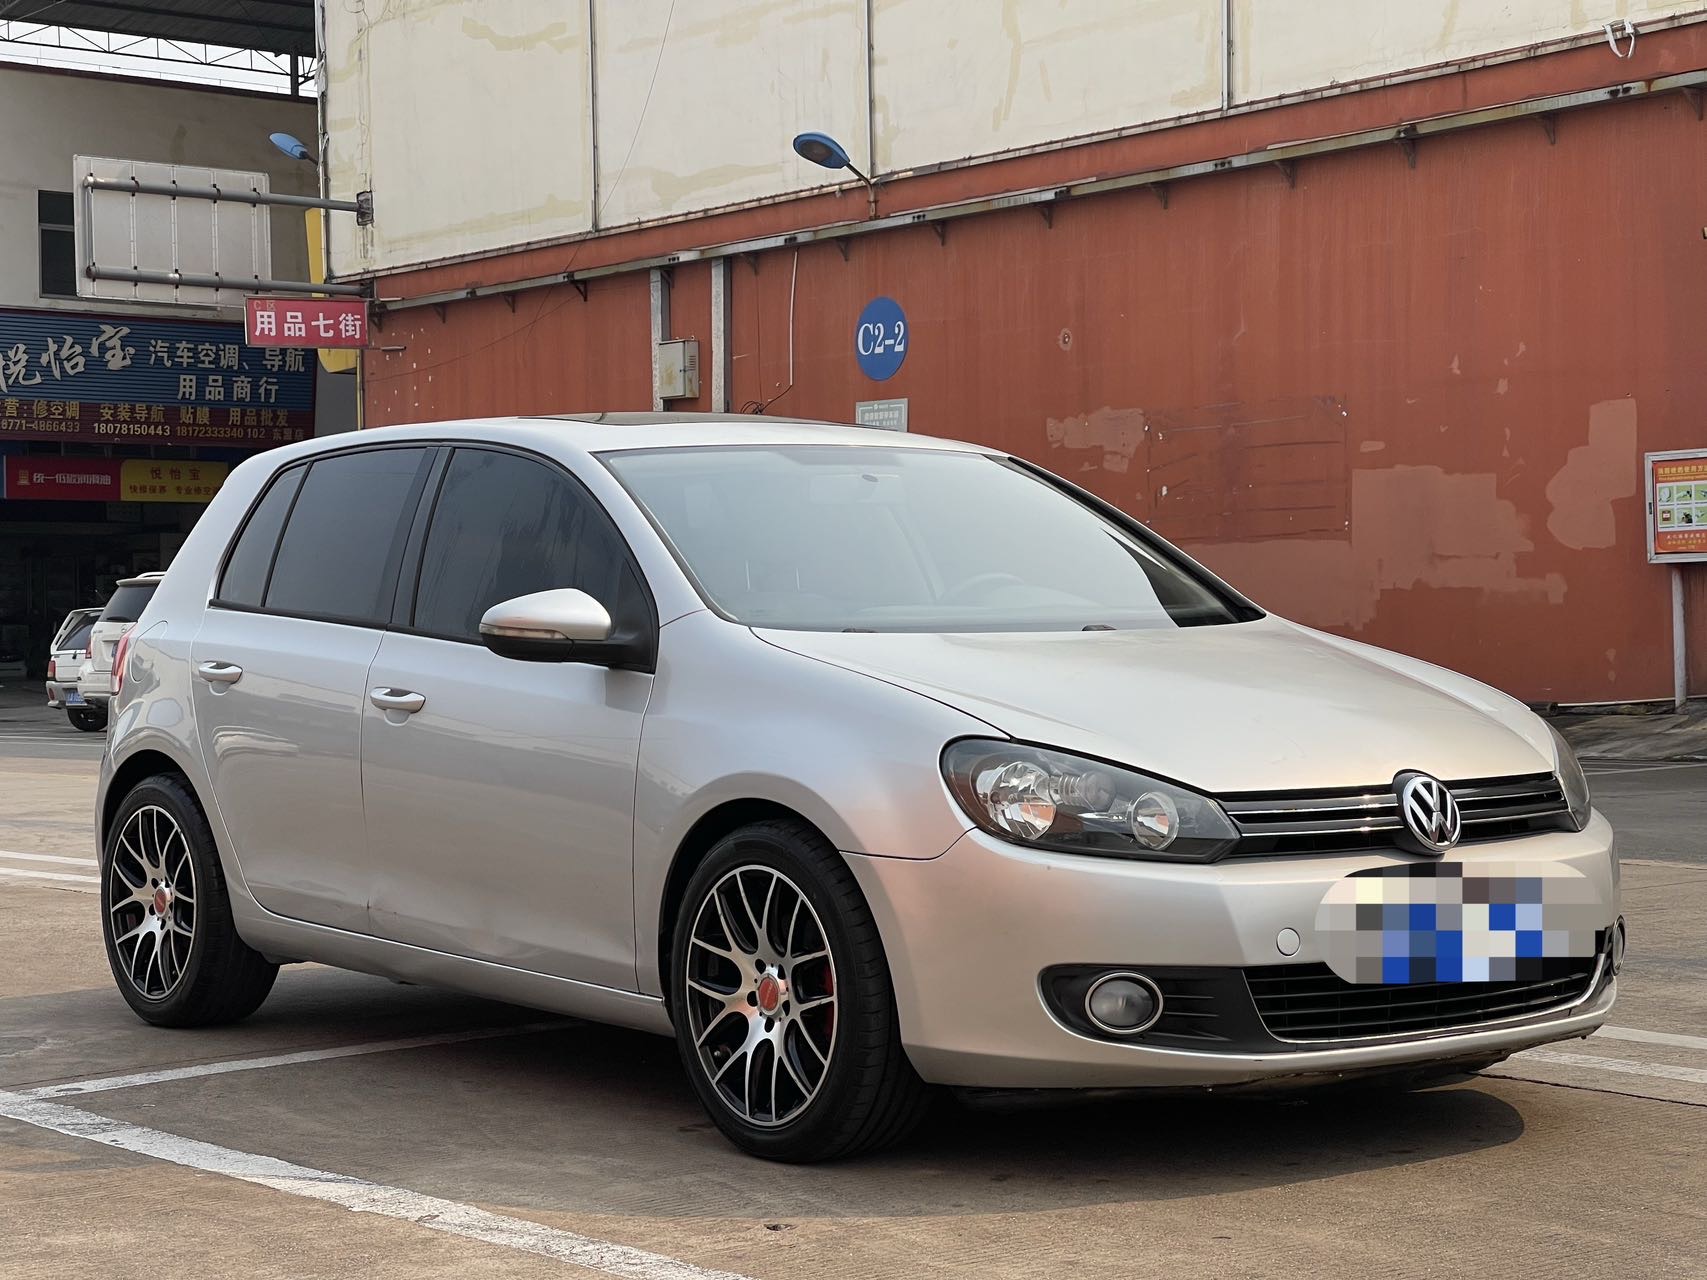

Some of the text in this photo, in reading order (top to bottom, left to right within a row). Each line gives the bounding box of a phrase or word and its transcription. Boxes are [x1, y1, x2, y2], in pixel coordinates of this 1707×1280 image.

[255, 310, 362, 339] 用品七街
[857, 320, 905, 355] C2-2
[177, 374, 279, 403] 用品商行
[100, 402, 165, 422] 安装导航
[180, 406, 210, 424] 贴膜
[228, 407, 289, 427] 用品批发
[93, 423, 171, 436] 18078150443
[176, 425, 244, 439] 18172333340
[150, 466, 202, 480] 悦怡宝
